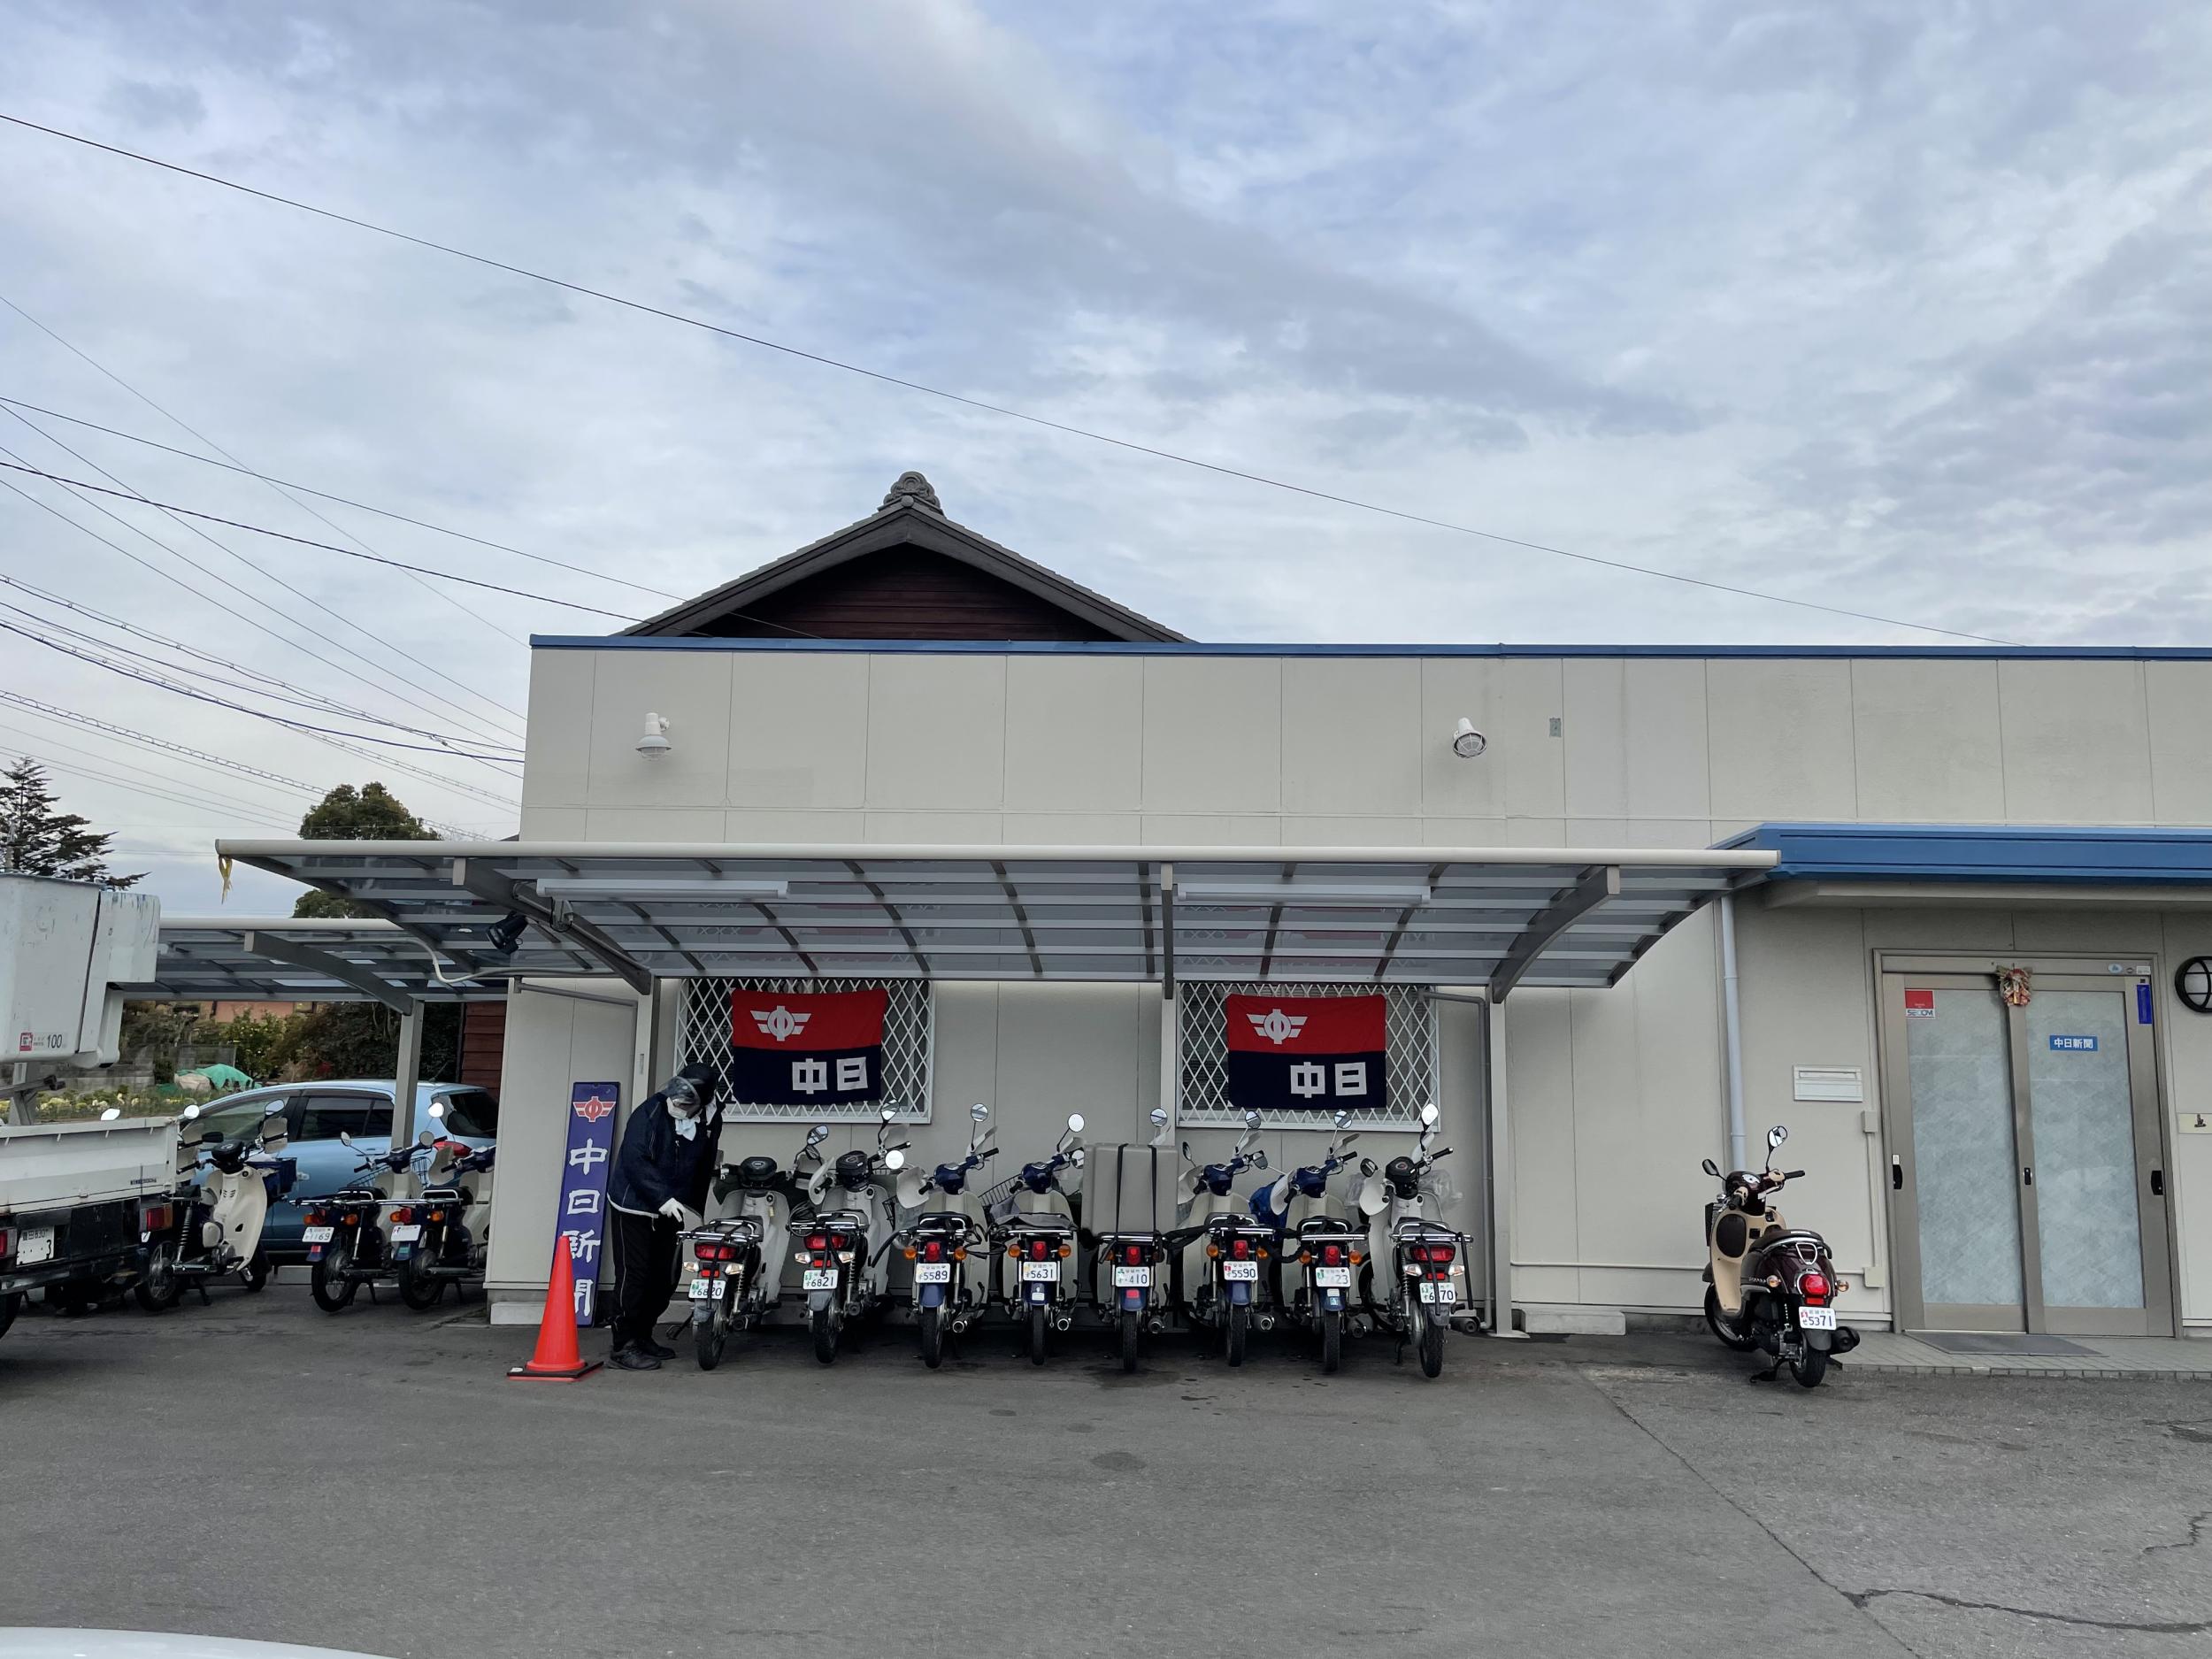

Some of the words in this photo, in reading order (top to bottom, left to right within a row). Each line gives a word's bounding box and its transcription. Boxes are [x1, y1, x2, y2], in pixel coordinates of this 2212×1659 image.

[47, 1034, 63, 1048] 100
[2054, 1037, 2093, 1049] 中日新聞
[792, 1056, 868, 1094] 中日
[1290, 1061, 1367, 1099] 中日
[923, 1270, 949, 1280] 5589
[1030, 1268, 1054, 1279] 5631
[1231, 1268, 1256, 1279] 5590
[810, 1277, 834, 1287] 6821
[1429, 1289, 1455, 1302] 670
[1808, 1315, 1833, 1327] 5371
